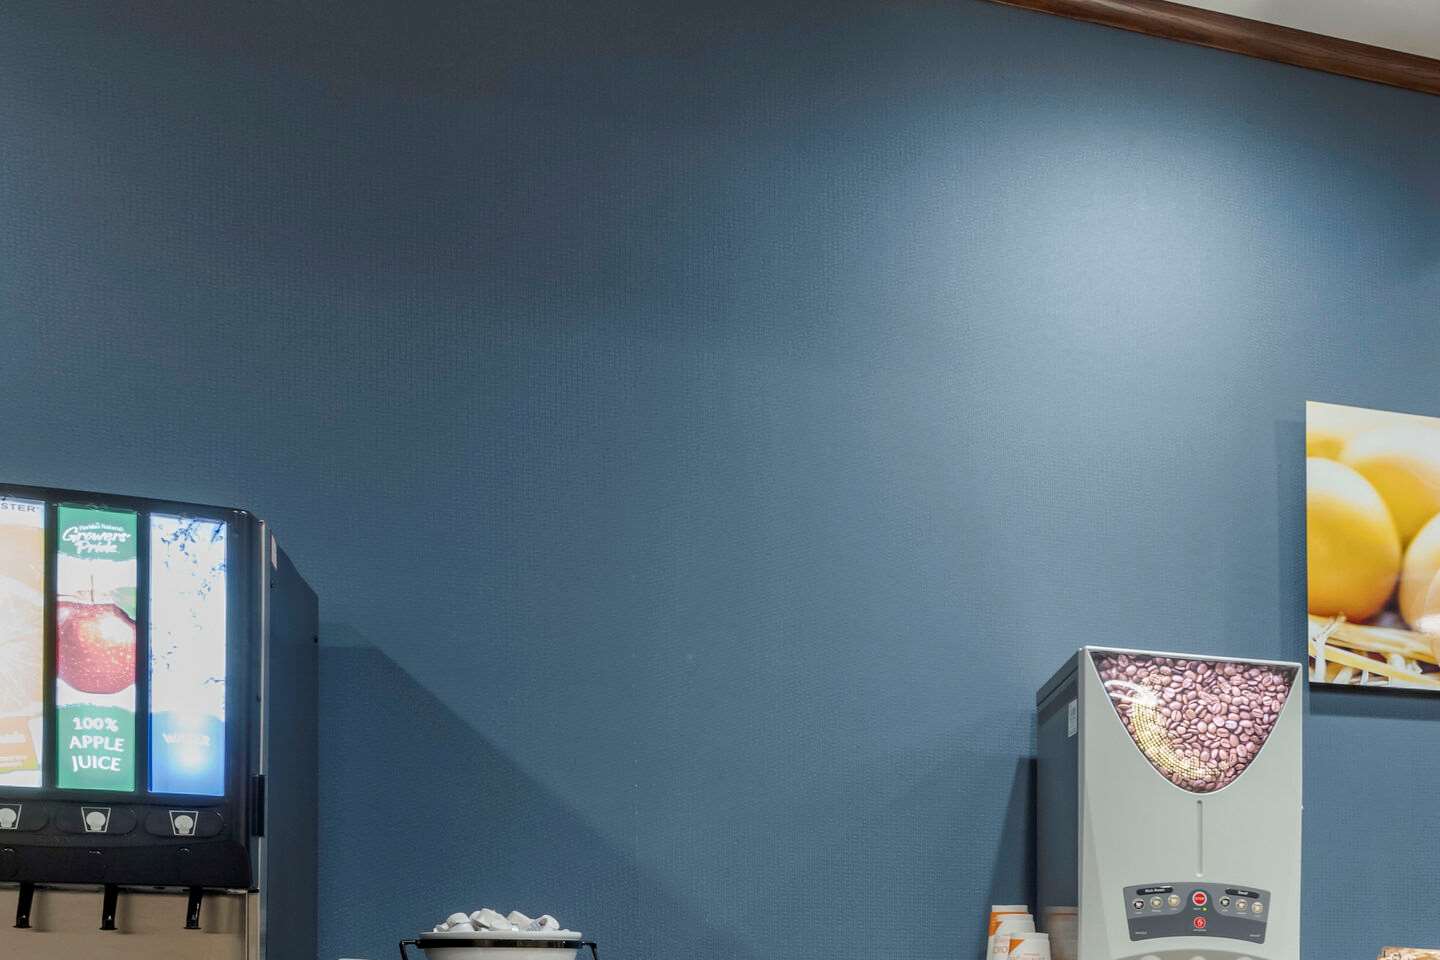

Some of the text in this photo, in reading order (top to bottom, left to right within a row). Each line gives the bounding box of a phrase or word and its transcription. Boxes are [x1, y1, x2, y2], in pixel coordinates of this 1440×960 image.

[72, 716, 119, 732] 100%
[69, 735, 125, 752] APPLE
[71, 755, 121, 772] JUICE
